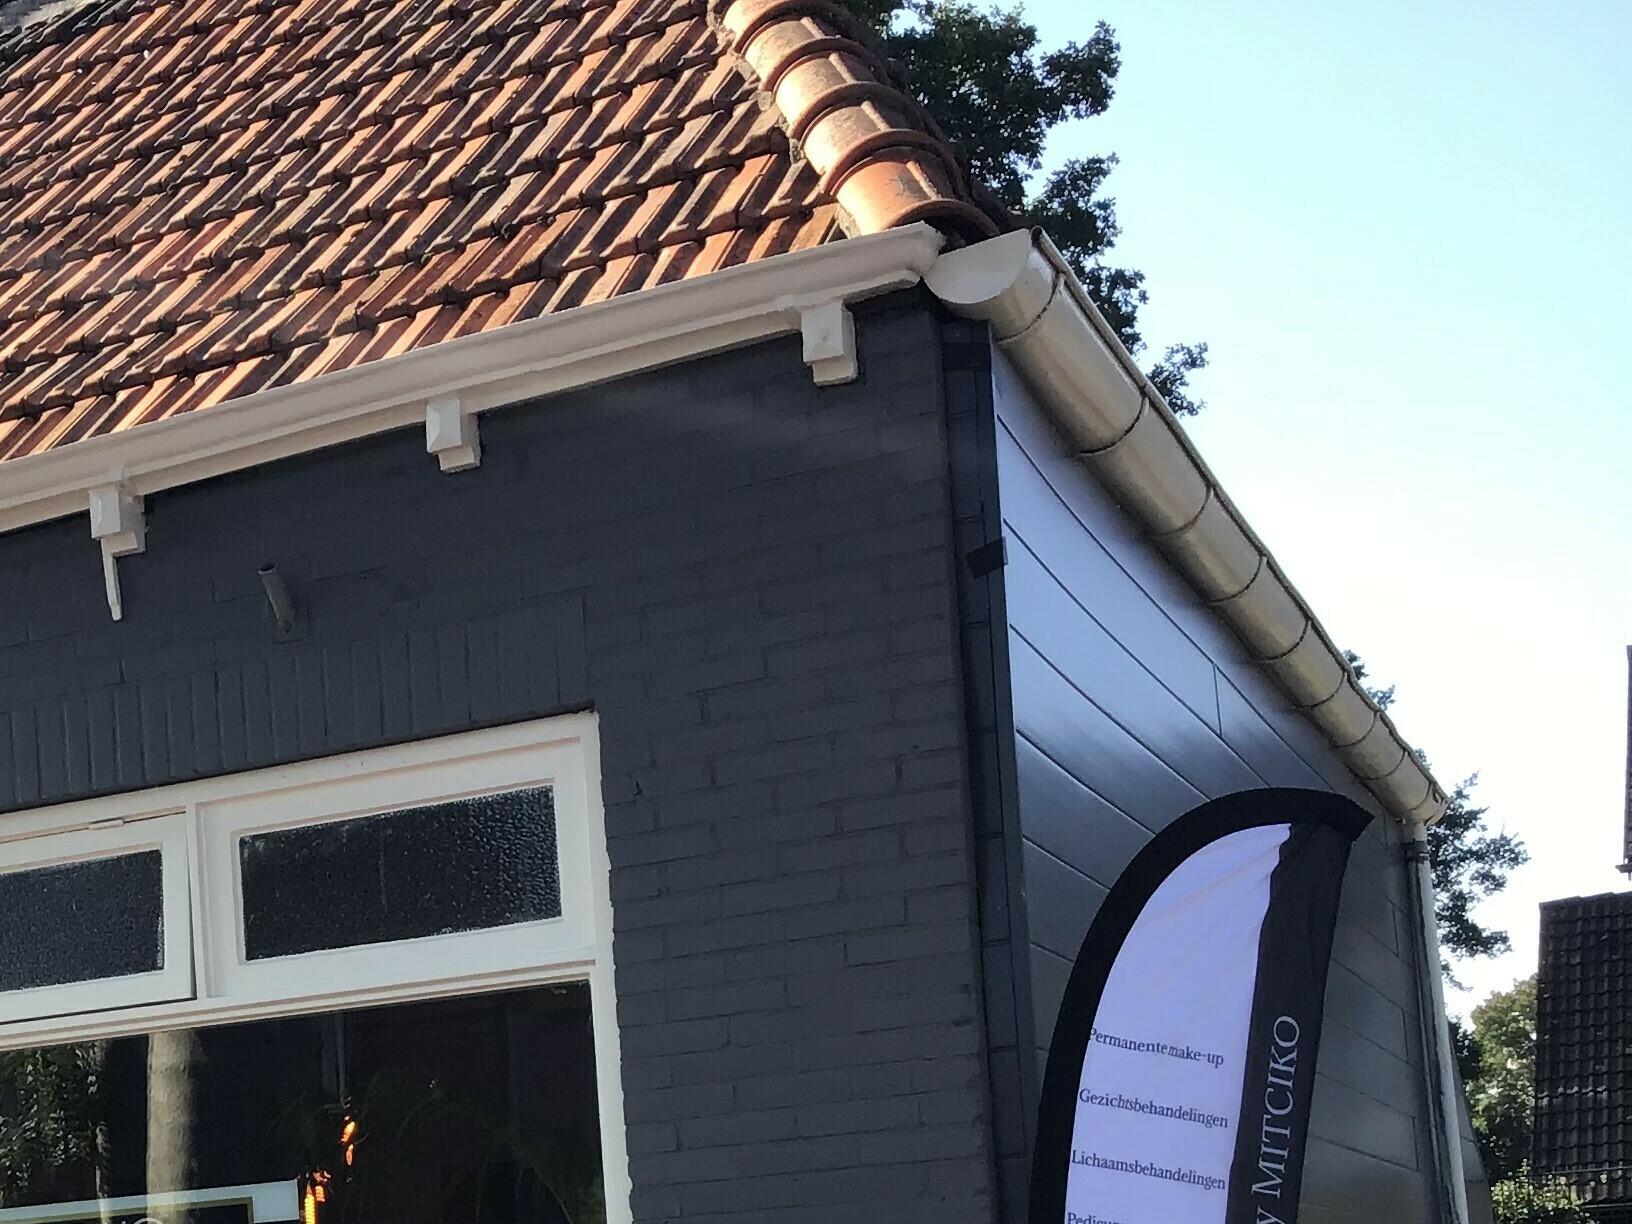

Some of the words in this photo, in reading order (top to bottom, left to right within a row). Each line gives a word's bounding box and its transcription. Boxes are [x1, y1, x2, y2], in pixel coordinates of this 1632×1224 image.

[1090, 1027, 1168, 1055] Permanente
[1167, 1045, 1225, 1069] make-up
[1079, 1087, 1229, 1129] Gezichtsbehandelingen
[1251, 1015, 1300, 1198] MITCIKO
[1071, 1149, 1226, 1191] Lichaamsbehandelingen
